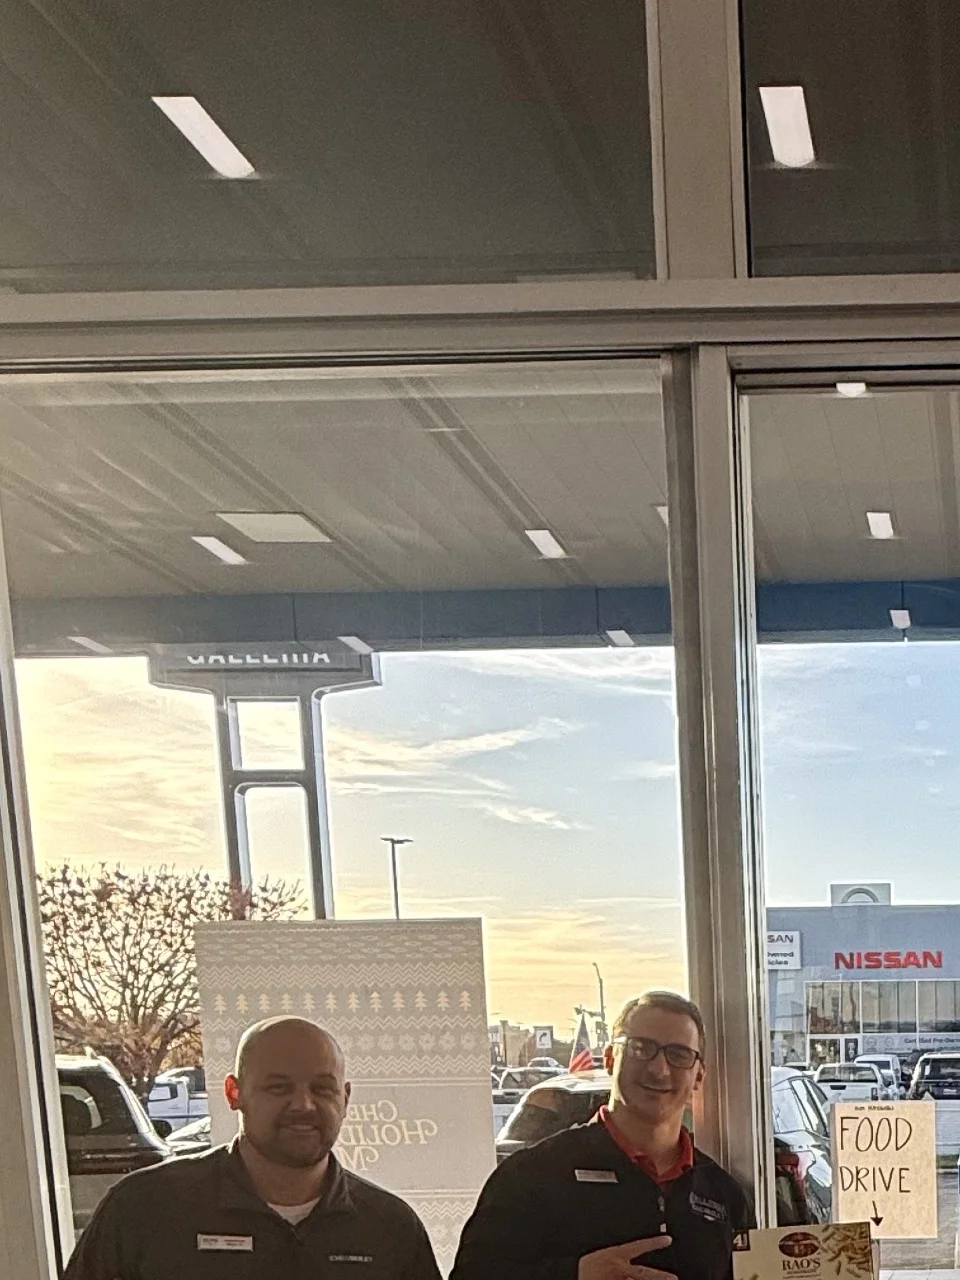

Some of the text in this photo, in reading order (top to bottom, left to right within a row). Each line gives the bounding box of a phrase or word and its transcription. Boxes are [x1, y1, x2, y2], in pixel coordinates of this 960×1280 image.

[766, 934, 794, 943] SAN
[834, 950, 943, 969] NISSAN
[839, 1116, 913, 1152] FOOD
[839, 1165, 911, 1193] DRIVE
[782, 1257, 821, 1271] RAO'S
